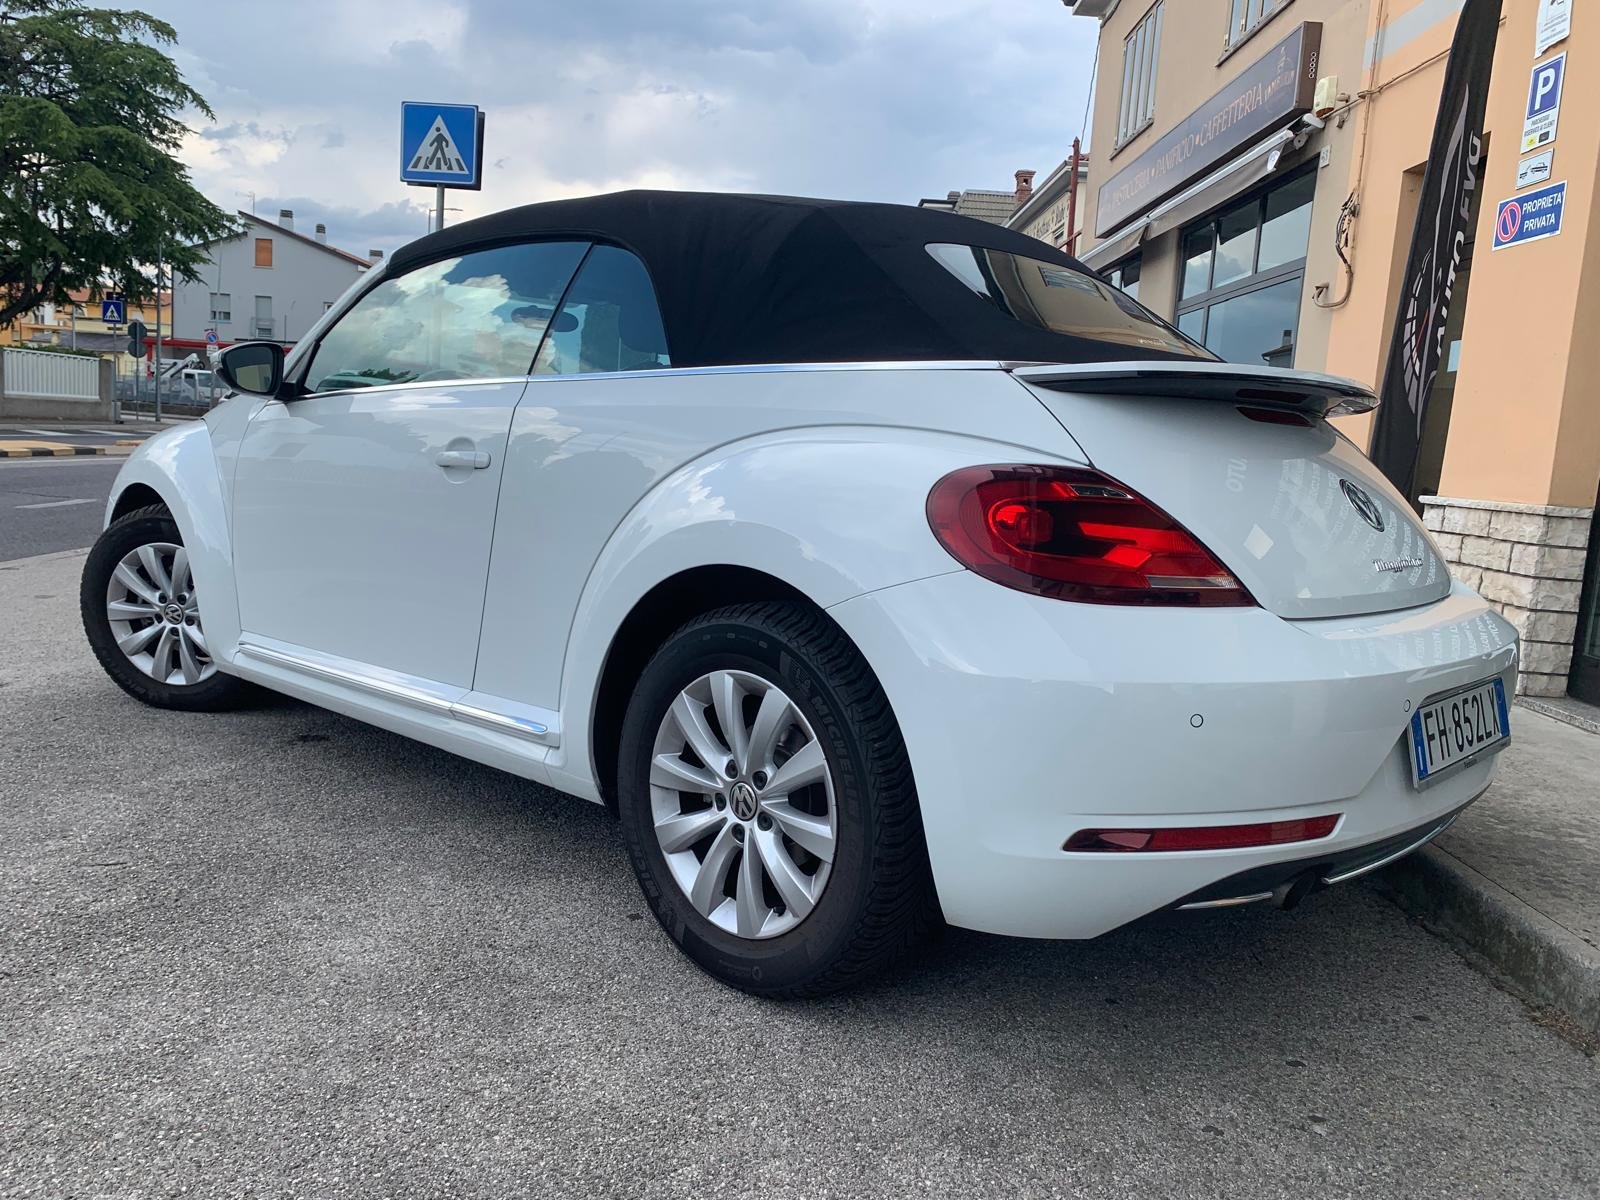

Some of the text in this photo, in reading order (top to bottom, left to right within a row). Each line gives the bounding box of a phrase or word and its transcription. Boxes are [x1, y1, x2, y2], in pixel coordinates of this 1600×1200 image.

[1534, 67, 1556, 111] P
[1155, 134, 1195, 177] PANIFICIO
[1200, 82, 1262, 147] CAFFETTERIA
[1523, 213, 1556, 232] PRIVATA
